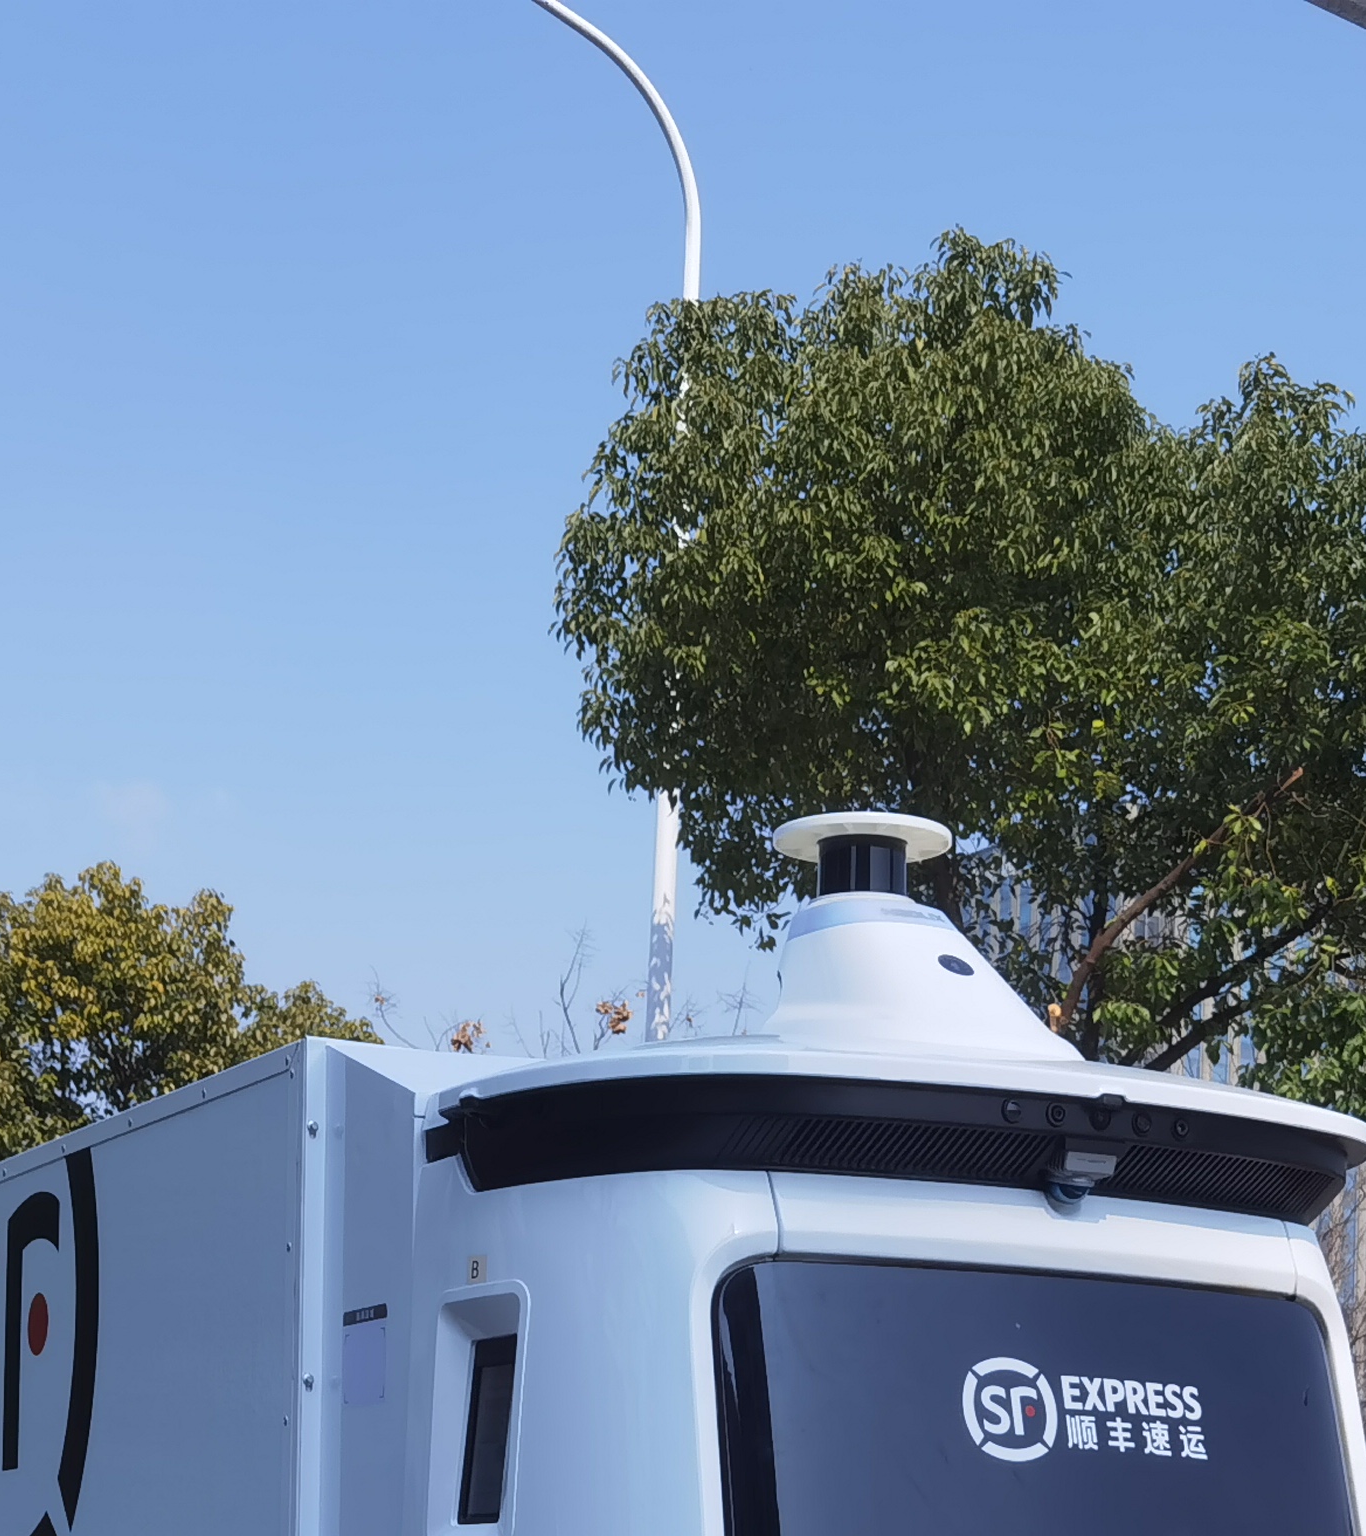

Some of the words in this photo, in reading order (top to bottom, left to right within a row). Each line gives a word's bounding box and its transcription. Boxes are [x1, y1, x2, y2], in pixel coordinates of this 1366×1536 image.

[470, 1260, 480, 1279] B
[1060, 1375, 1203, 1421] EXPRESS
[1065, 1414, 1209, 1460] 顺丰速运
